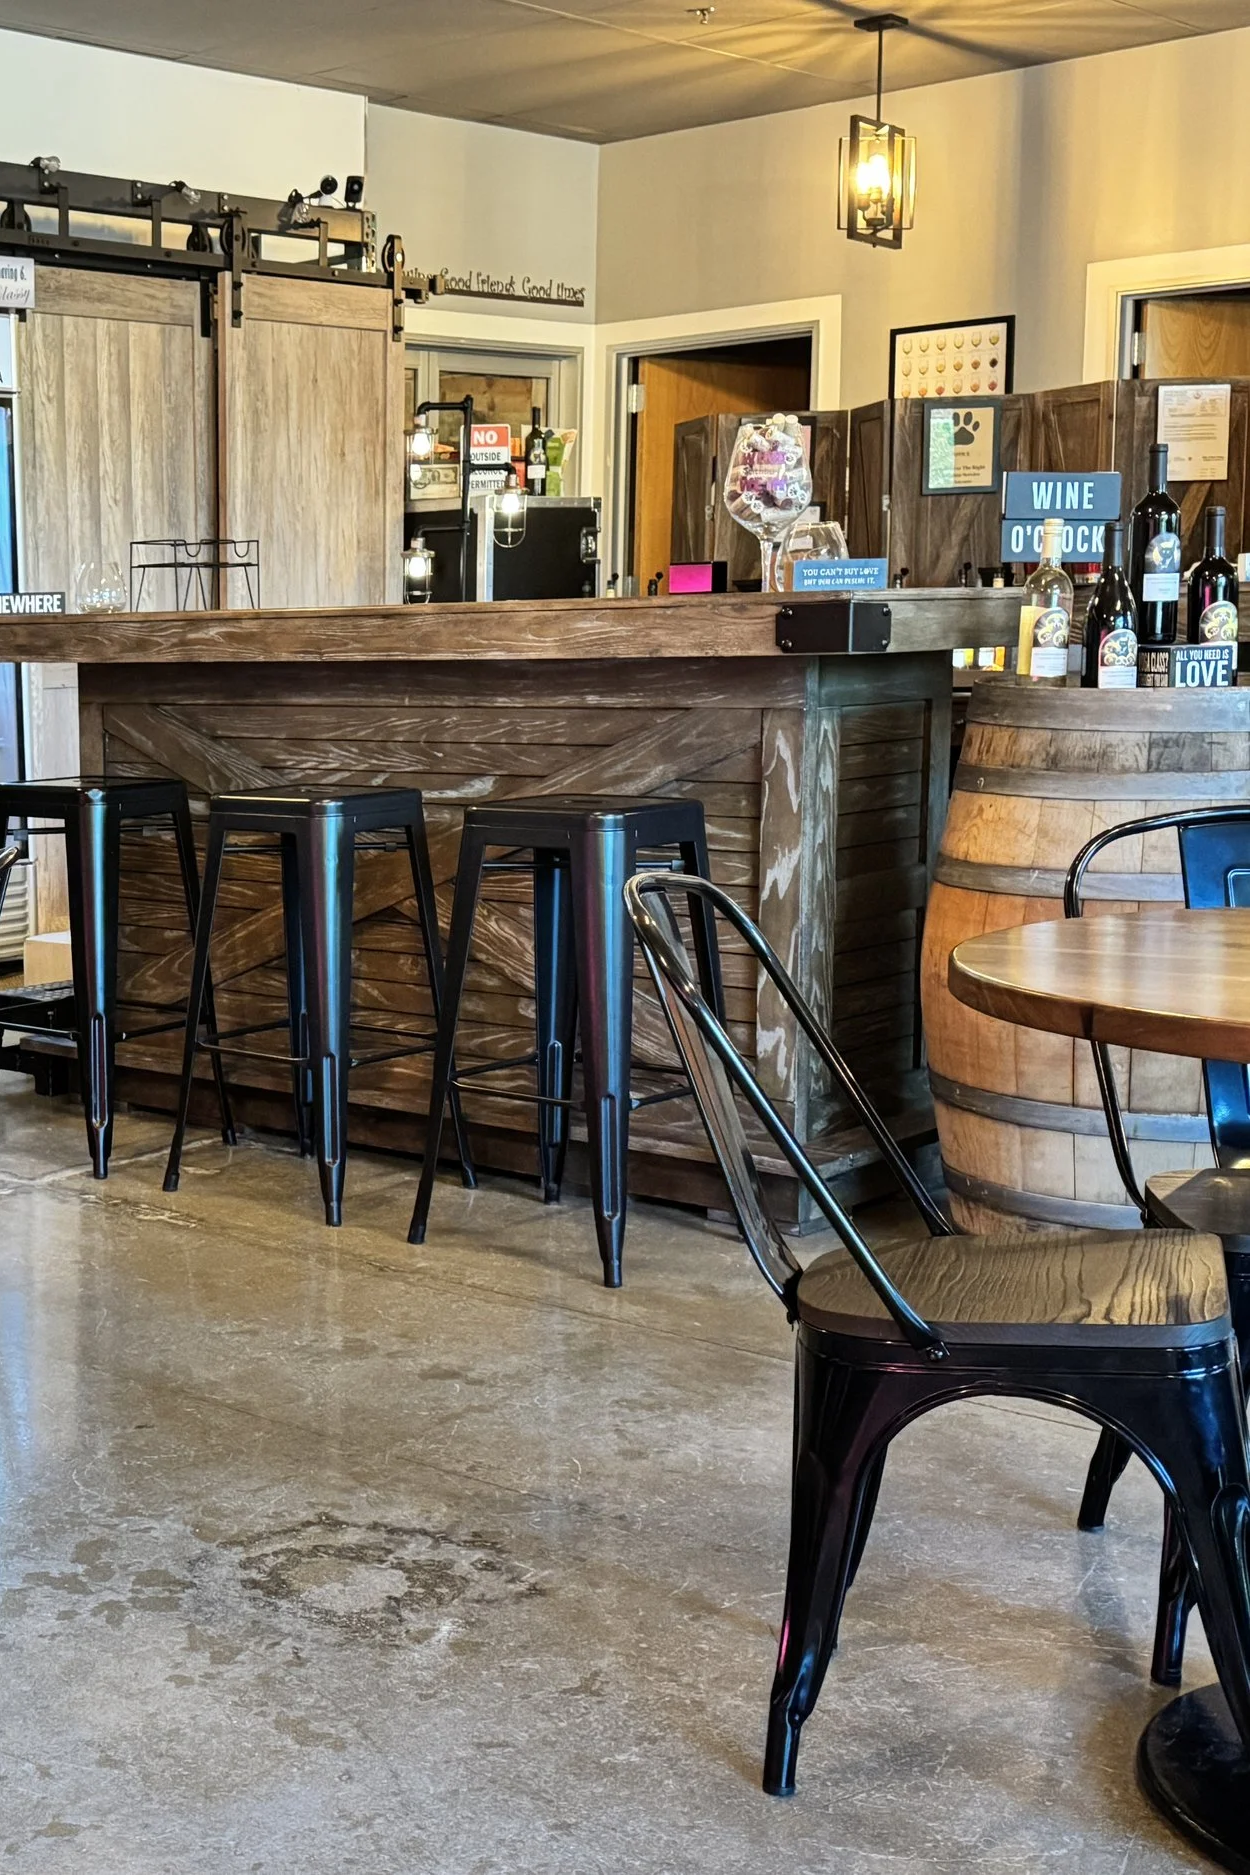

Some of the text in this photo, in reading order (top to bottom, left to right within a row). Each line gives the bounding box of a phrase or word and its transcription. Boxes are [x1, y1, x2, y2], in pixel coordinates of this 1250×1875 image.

[522, 276, 552, 299] Good
[473, 430, 498, 445] NO
[470, 452, 501, 461] OUTSIDE
[471, 480, 505, 489] ERMITTE
[1032, 481, 1095, 510] WINE
[1011, 525, 1105, 553] O'COCK
[803, 569, 819, 577] YOU
[820, 567, 843, 576] CAN'T
[844, 568, 859, 576] BUY
[1176, 648, 1229, 661] ALL YOU NEED IS
[1175, 660, 1228, 687] LOVE
